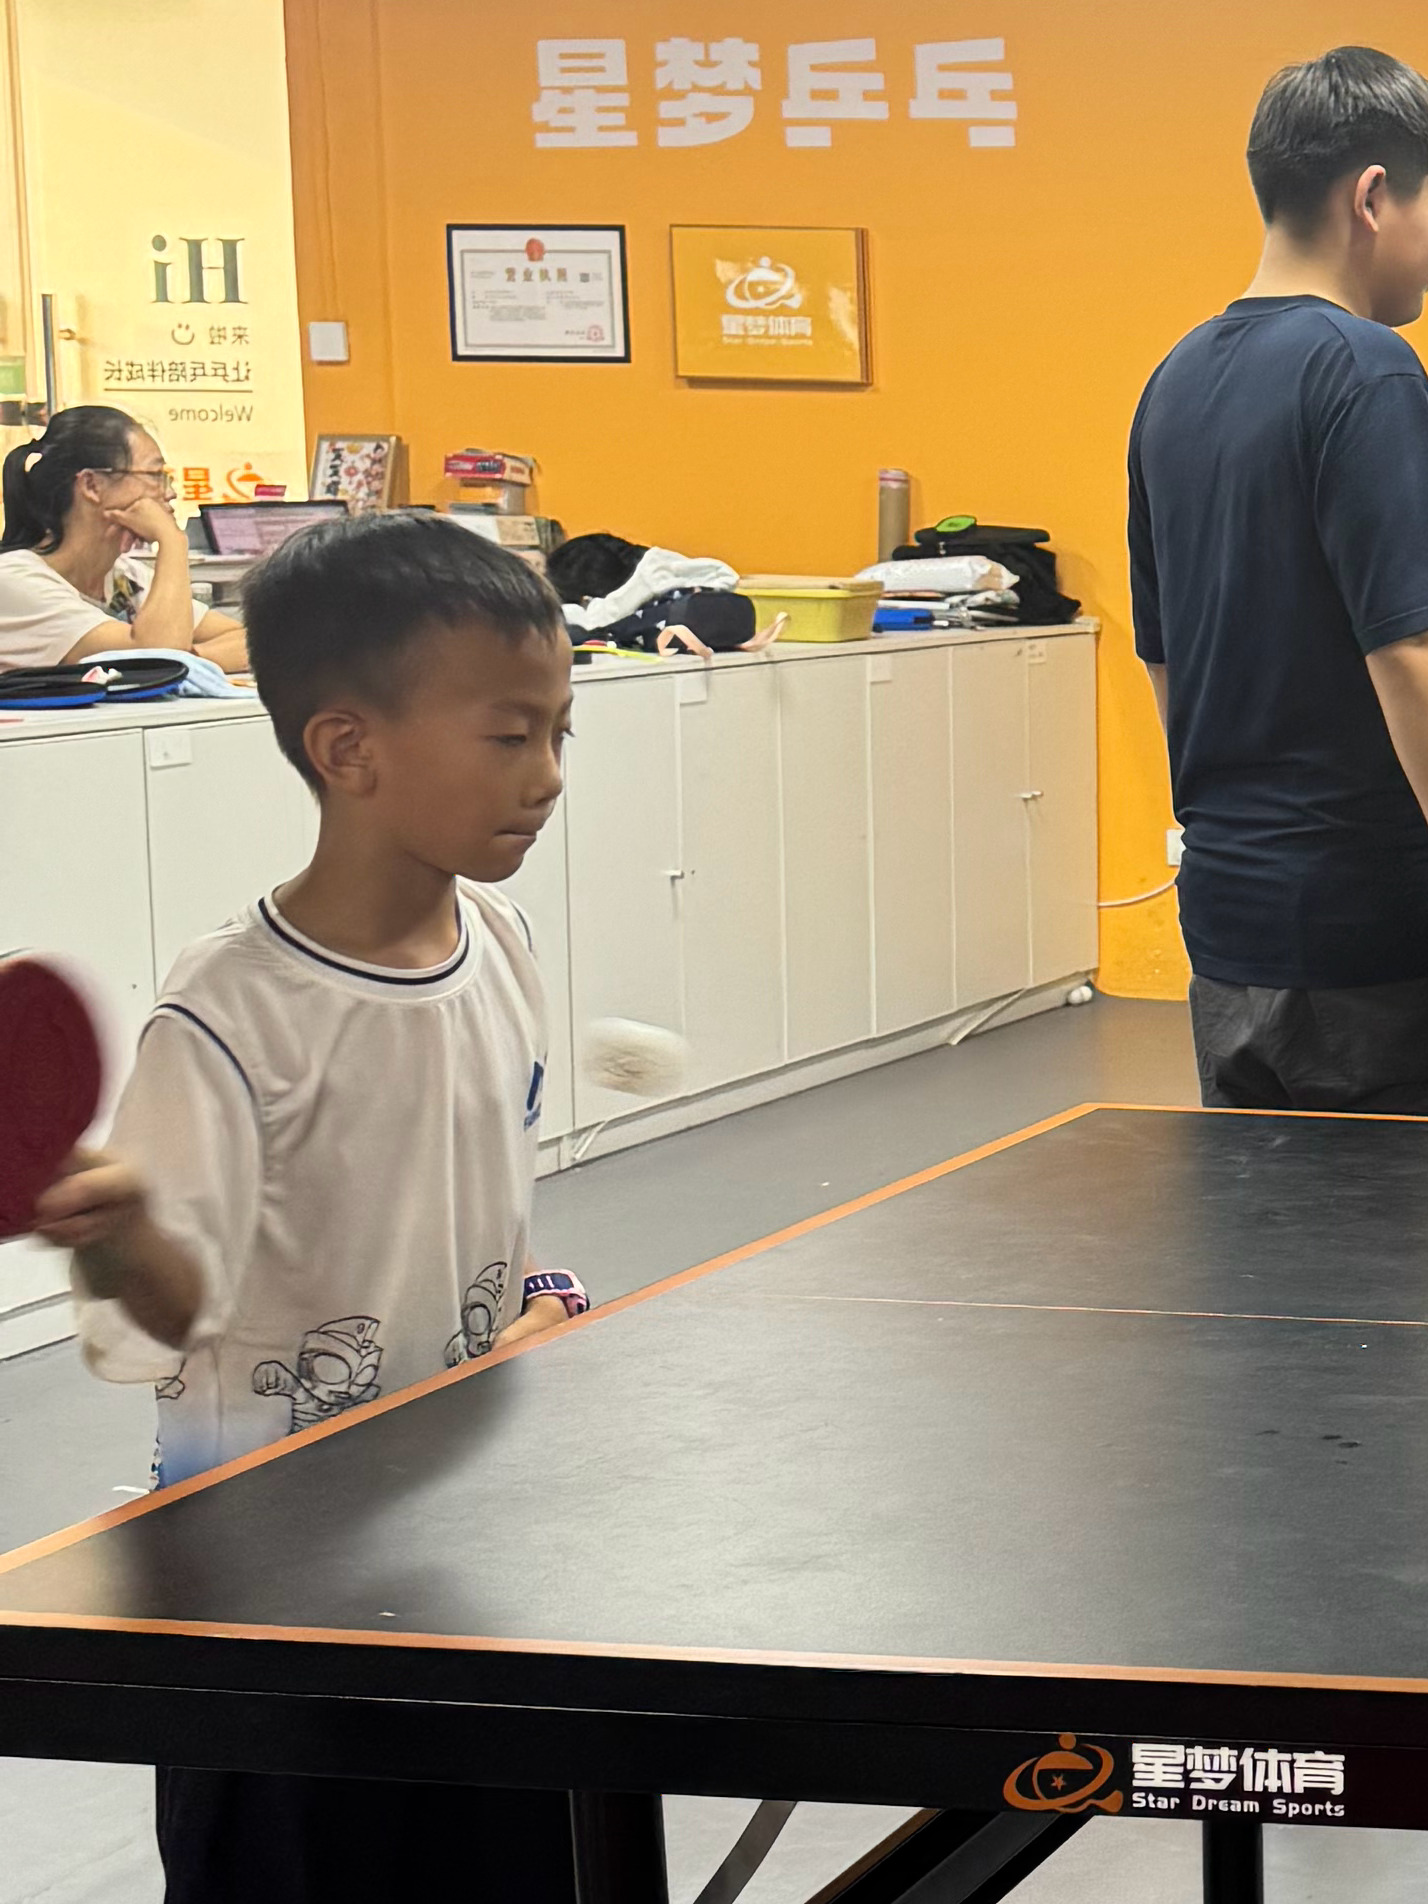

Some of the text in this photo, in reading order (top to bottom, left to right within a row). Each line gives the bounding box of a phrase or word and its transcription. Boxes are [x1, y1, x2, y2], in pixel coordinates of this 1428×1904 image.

[532, 37, 1018, 148] 星梦乒乓
[1132, 1743, 1345, 1795] 星梦体育
[1132, 1792, 1345, 1817] Star Dream Sports
